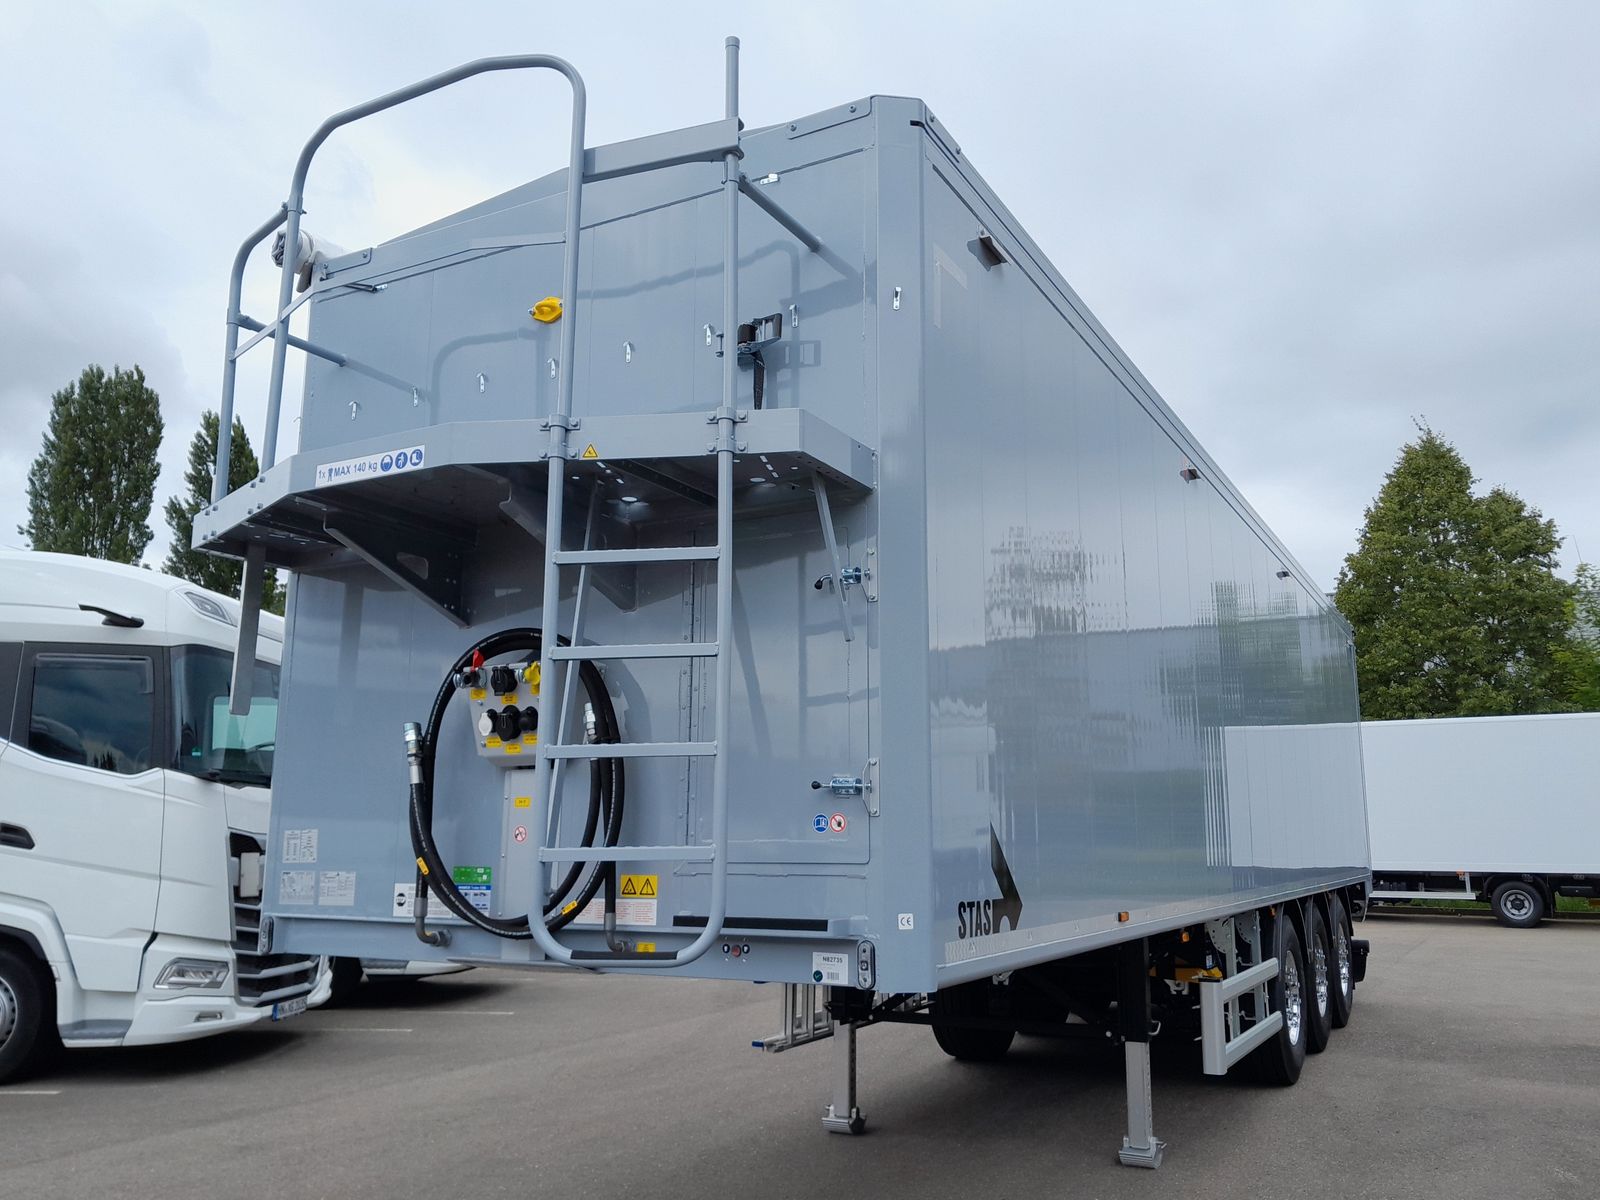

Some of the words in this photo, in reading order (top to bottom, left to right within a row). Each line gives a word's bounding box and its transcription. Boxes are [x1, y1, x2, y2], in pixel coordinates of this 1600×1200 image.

[318, 470, 326, 479] 1x
[333, 464, 351, 477] MAX
[354, 462, 366, 473] 140
[368, 461, 378, 472] kg
[900, 916, 912, 927] CE
[958, 899, 991, 940] STAS
